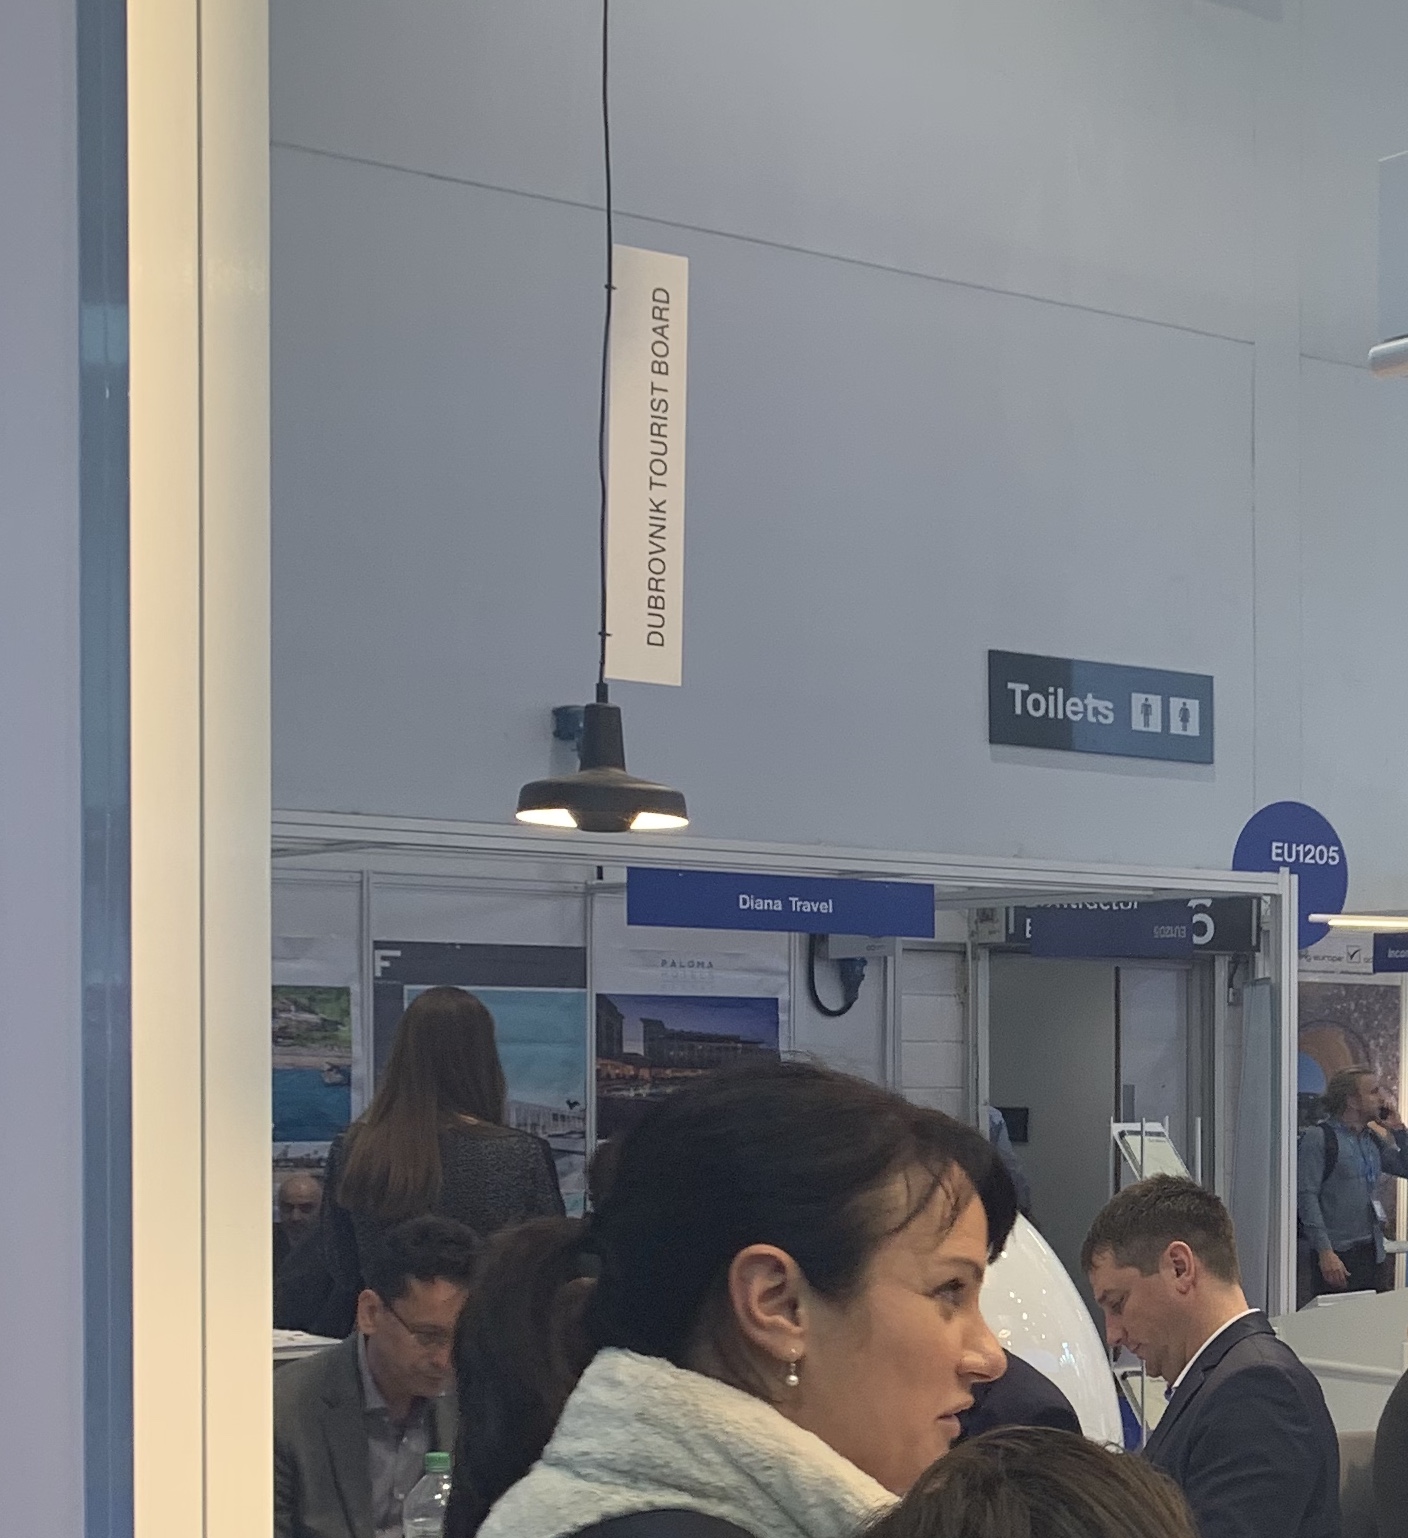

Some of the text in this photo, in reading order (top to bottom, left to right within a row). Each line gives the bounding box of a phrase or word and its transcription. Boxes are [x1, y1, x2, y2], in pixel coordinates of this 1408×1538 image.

[646, 286, 671, 648] DUBROVNIK TOURIST BOARD
[1007, 682, 1115, 725] Toilets
[1271, 841, 1340, 866] EU1205
[739, 894, 834, 914] Diana Travel
[660, 958, 714, 969] PALOMA
